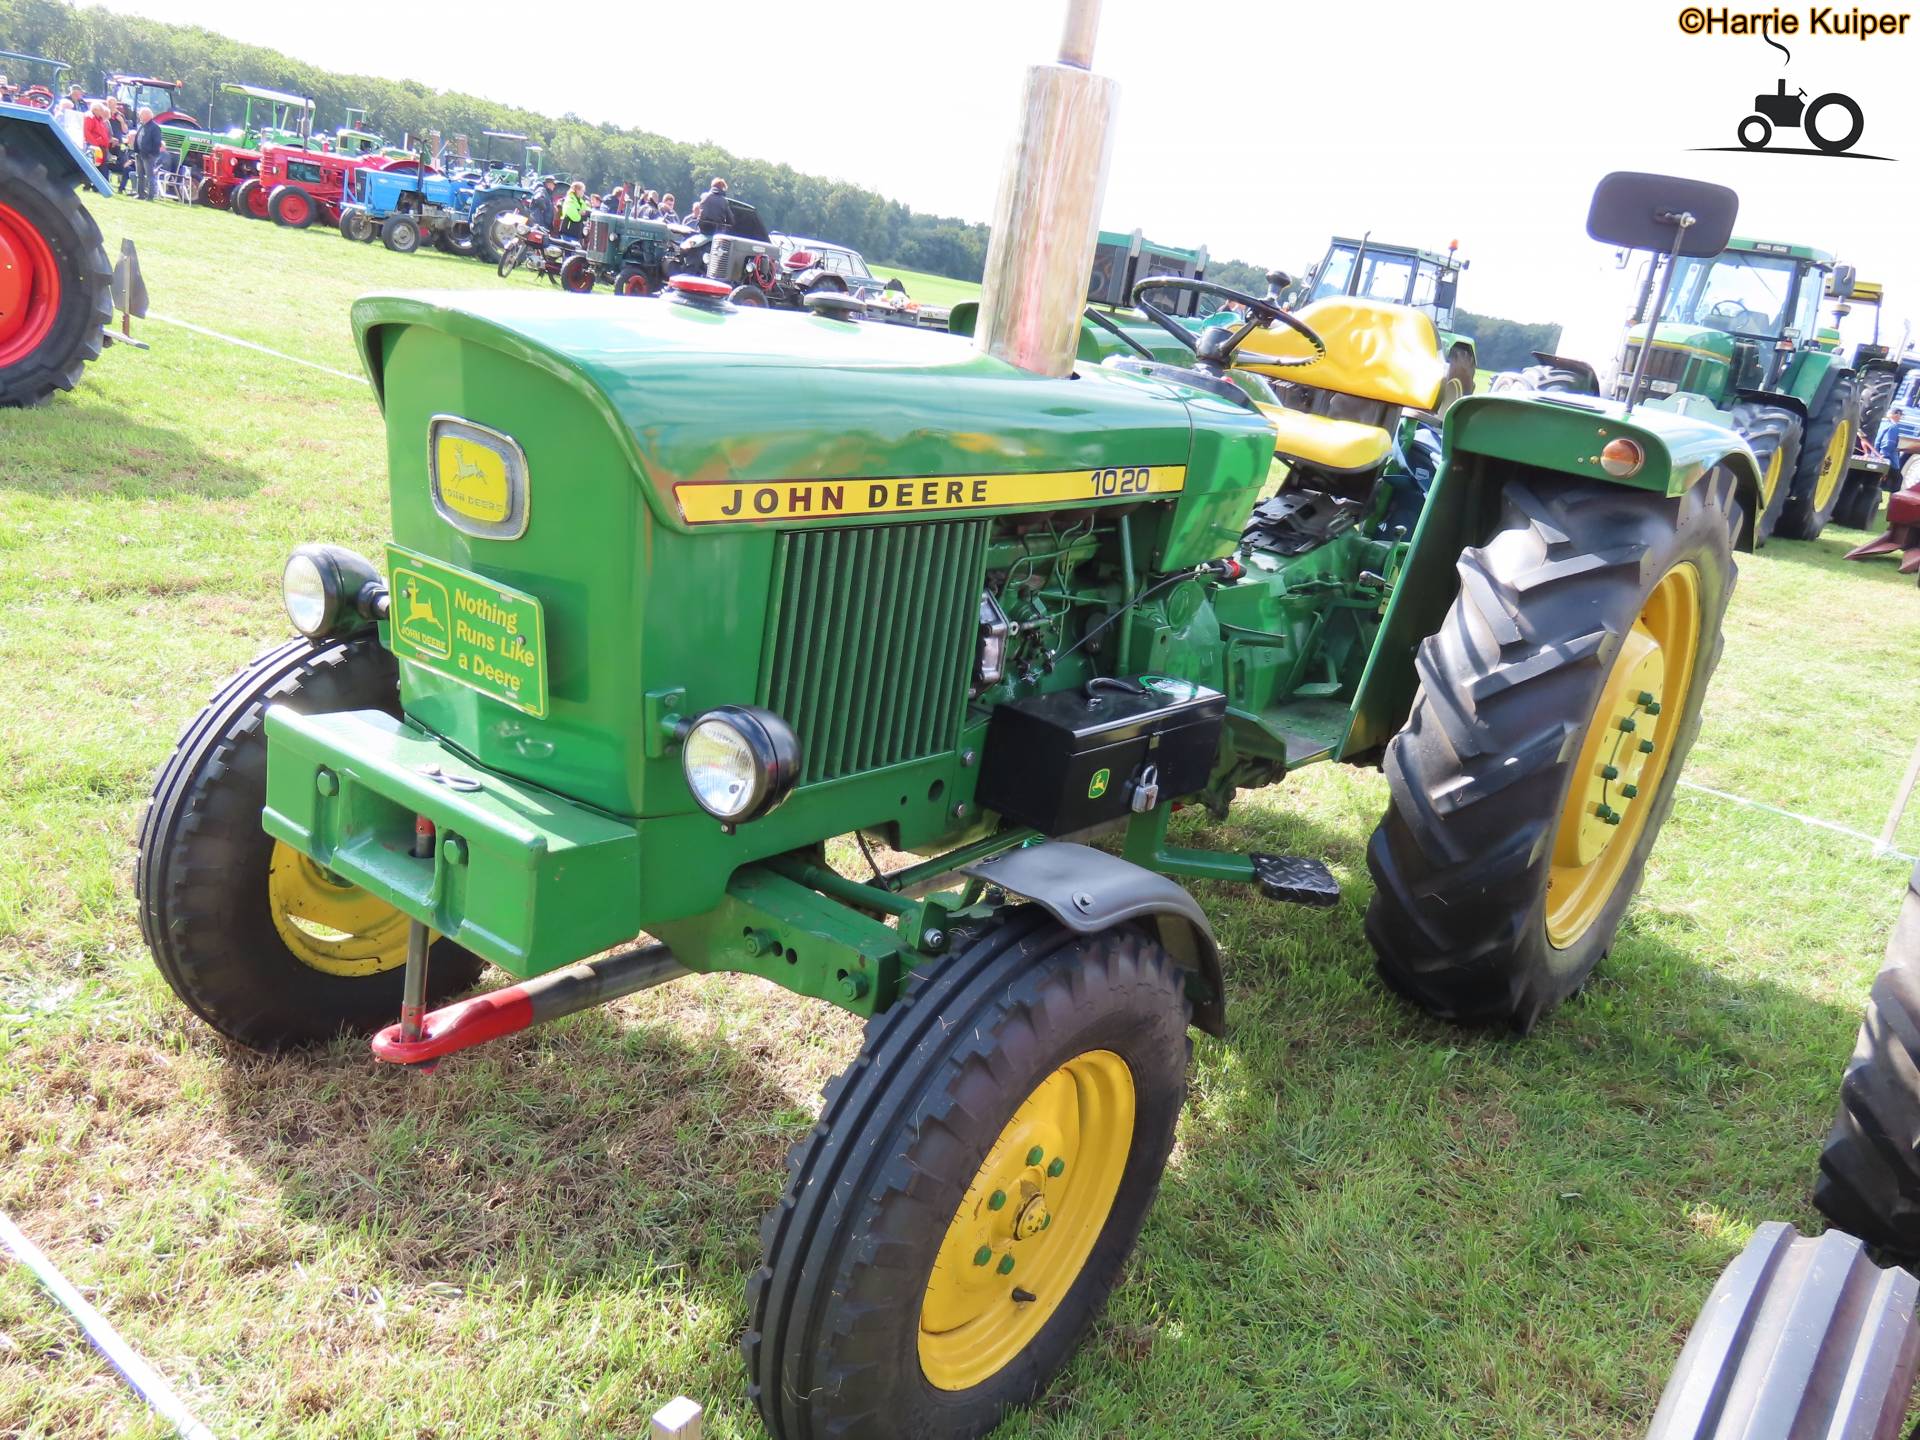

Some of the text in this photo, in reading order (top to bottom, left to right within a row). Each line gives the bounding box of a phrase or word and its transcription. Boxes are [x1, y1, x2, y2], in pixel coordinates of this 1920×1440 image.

[467, 495, 503, 512] DEERE
[721, 468, 1149, 516] JOHN DEERE 1020
[454, 588, 517, 635] Nothing
[421, 632, 446, 650] DEERE
[456, 619, 535, 667] Runs Like
[458, 652, 521, 692] a Deere
